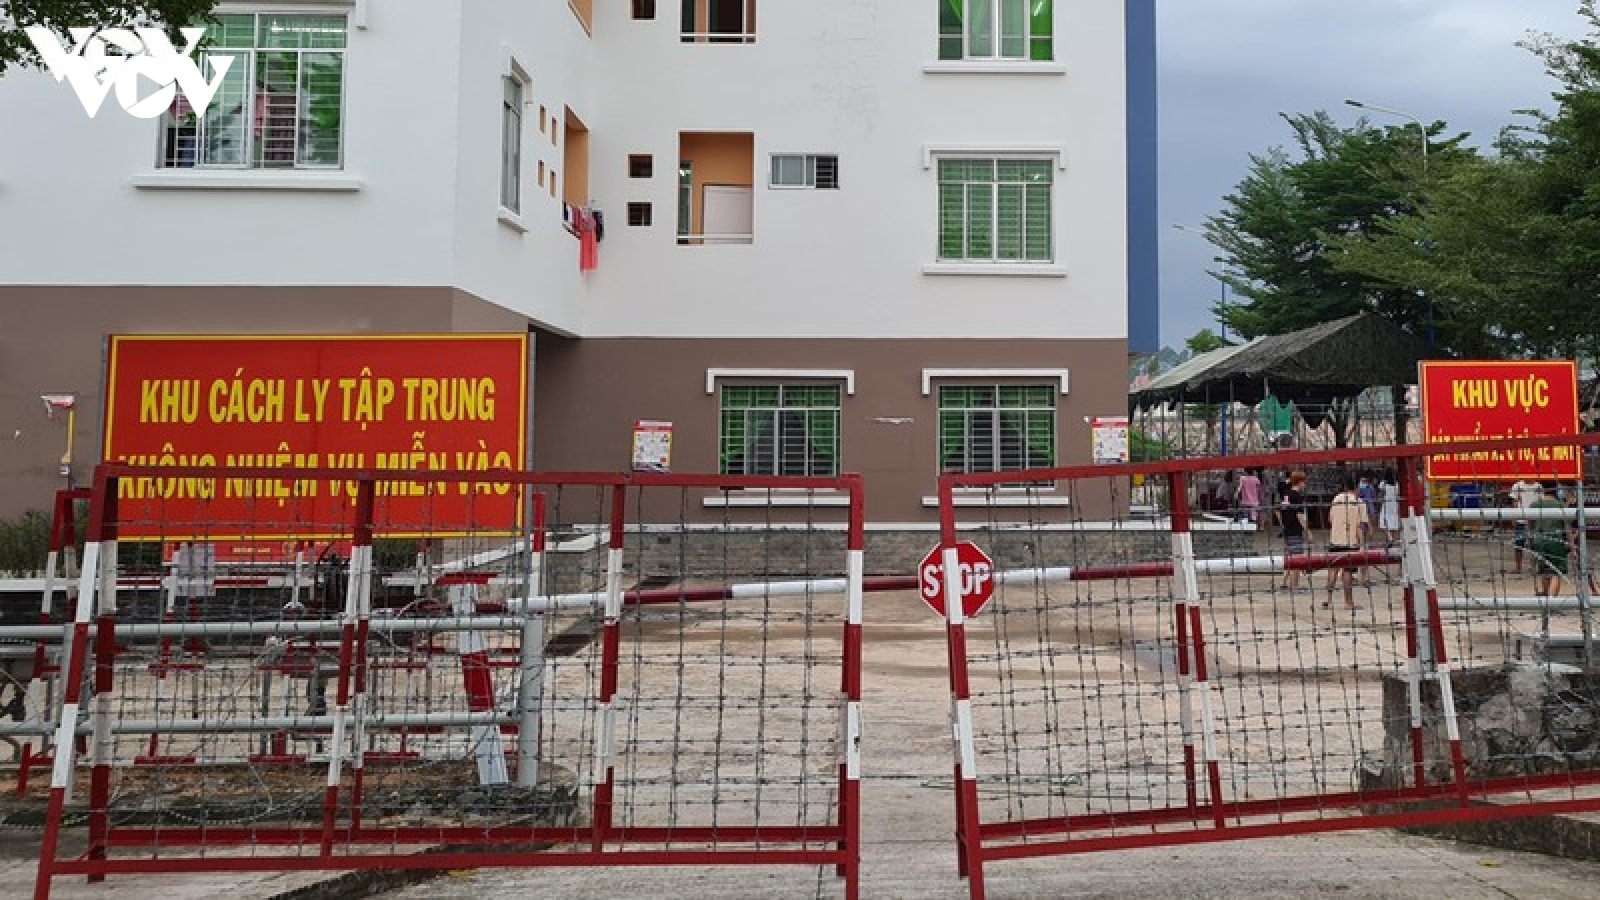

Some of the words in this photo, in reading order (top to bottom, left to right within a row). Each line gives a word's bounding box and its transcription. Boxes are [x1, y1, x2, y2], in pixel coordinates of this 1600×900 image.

[140, 379, 201, 422] KHU
[209, 368, 285, 422] CÁCH
[294, 379, 331, 422] LY
[339, 366, 395, 431] TẬP
[402, 377, 496, 421] TRUNG
[1453, 379, 1498, 408] KHU
[1503, 373, 1549, 413] VỰC
[117, 442, 217, 499] KHÔNG
[455, 440, 512, 497] VÀO
[923, 562, 990, 597] SOP
